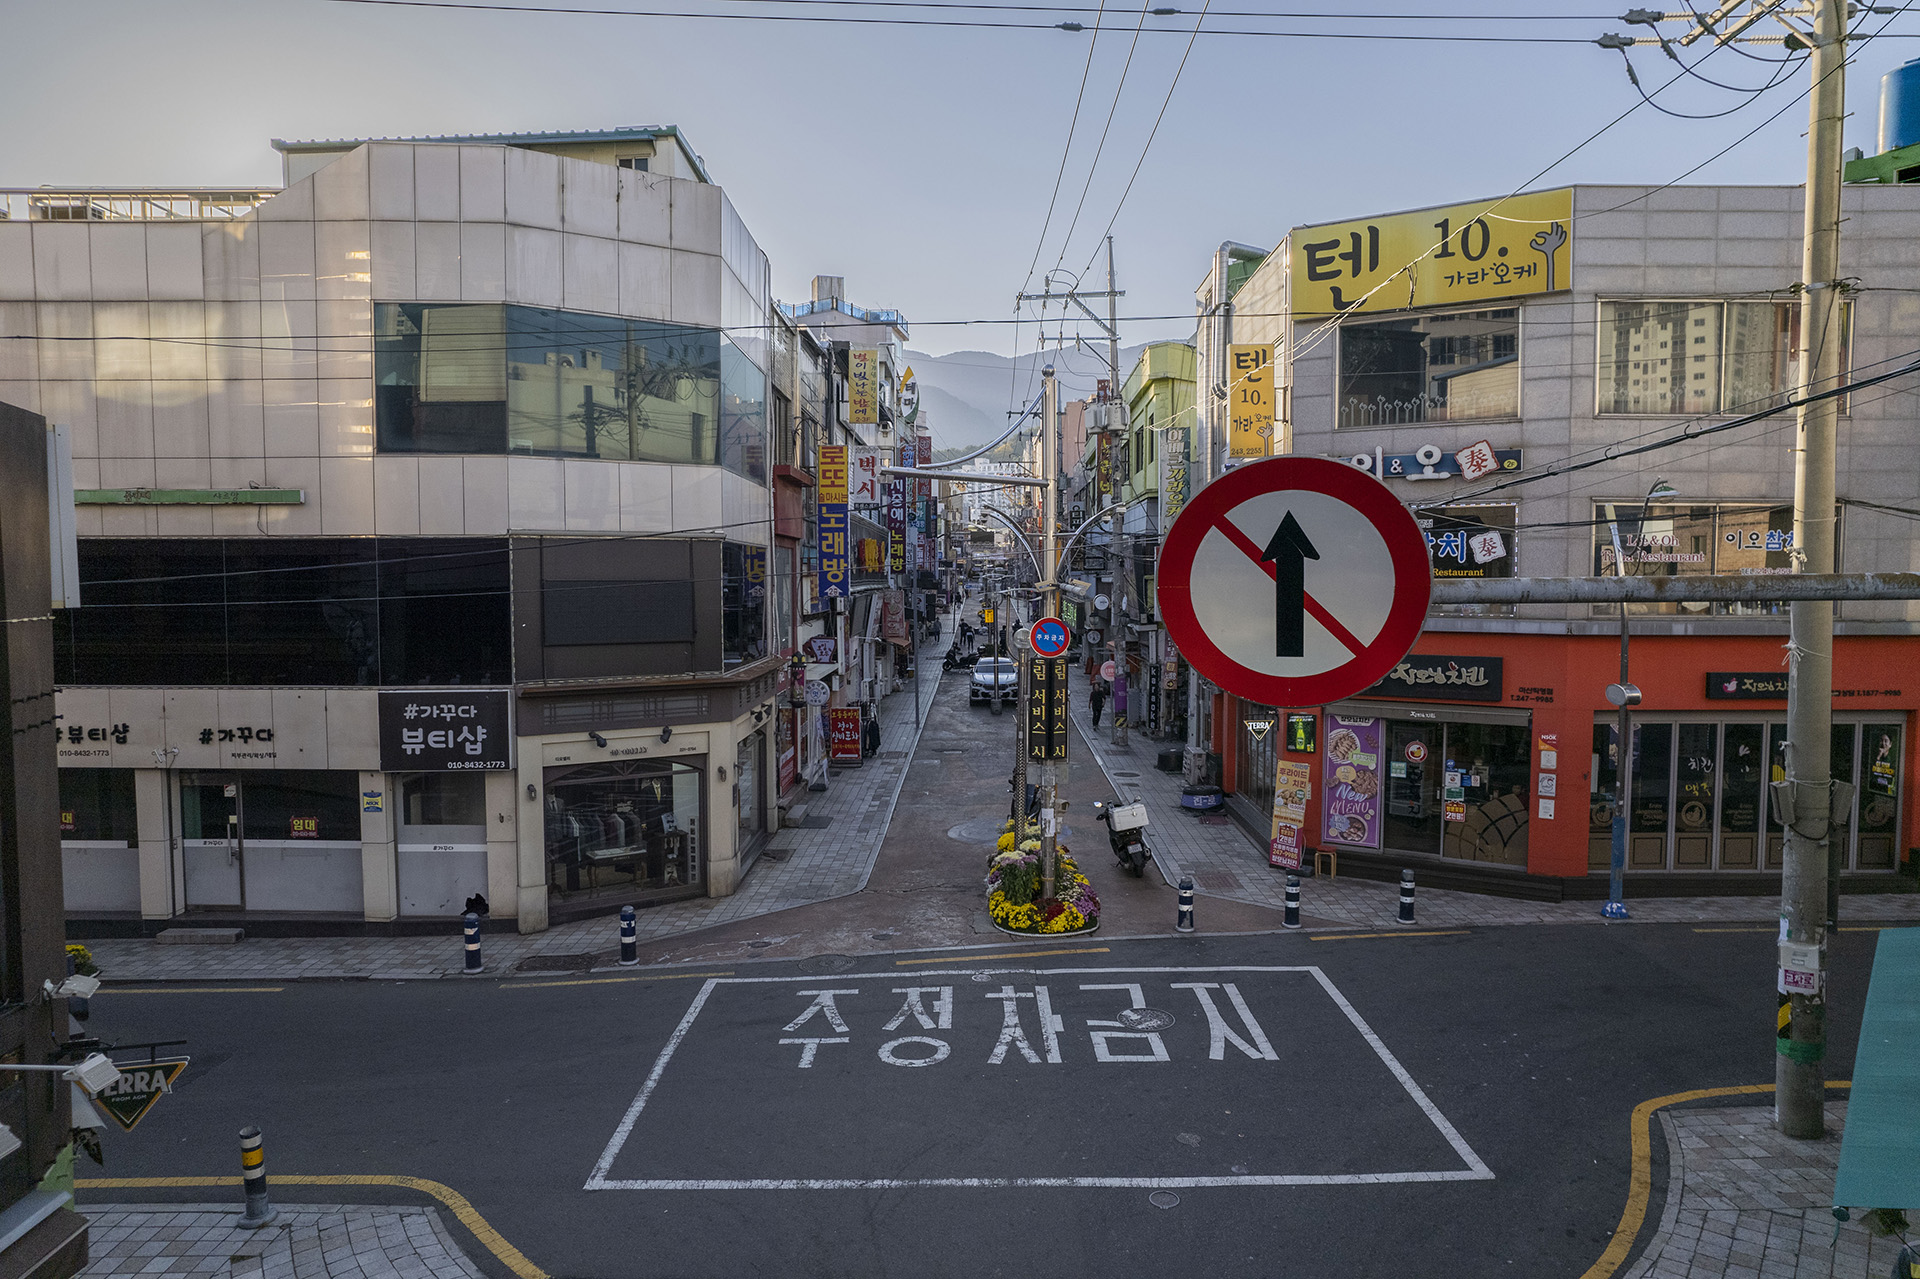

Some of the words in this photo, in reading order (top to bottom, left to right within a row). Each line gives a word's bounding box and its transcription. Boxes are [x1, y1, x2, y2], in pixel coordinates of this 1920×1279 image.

[1434, 218, 1508, 261] 10.
[1303, 225, 1380, 311] 텐
[1443, 262, 1537, 287] 가라오케
[1234, 349, 1267, 382] 텐
[904, 382, 916, 409] 테마
[1241, 388, 1267, 405] 10.
[820, 446, 845, 488] 로또
[1465, 449, 1488, 474] 泰
[856, 455, 877, 501] 벽시
[820, 506, 847, 583] 노래방
[890, 530, 904, 572] 노래방
[1432, 568, 1484, 577] Restaurant
[1036, 633, 1065, 642] 주차금지
[1390, 661, 1489, 686] 장모님치킨
[403, 703, 478, 721] #가꾸다
[1032, 689, 1046, 735] 서비스
[1053, 688, 1066, 734] 서비스
[199, 727, 274, 744] #가꾸다
[1248, 721, 1271, 731] TERRA
[401, 725, 488, 755] 뷰티샵
[447, 761, 505, 769] 010-8432-1773
[1279, 767, 1308, 780] 후라이드
[1688, 757, 1713, 773] 치킨
[1292, 779, 1307, 789] 치킨
[1336, 784, 1368, 802] New
[293, 818, 316, 831] 임대
[1272, 848, 1298, 860] 247-9985
[777, 983, 1280, 1068] 주정차금지
